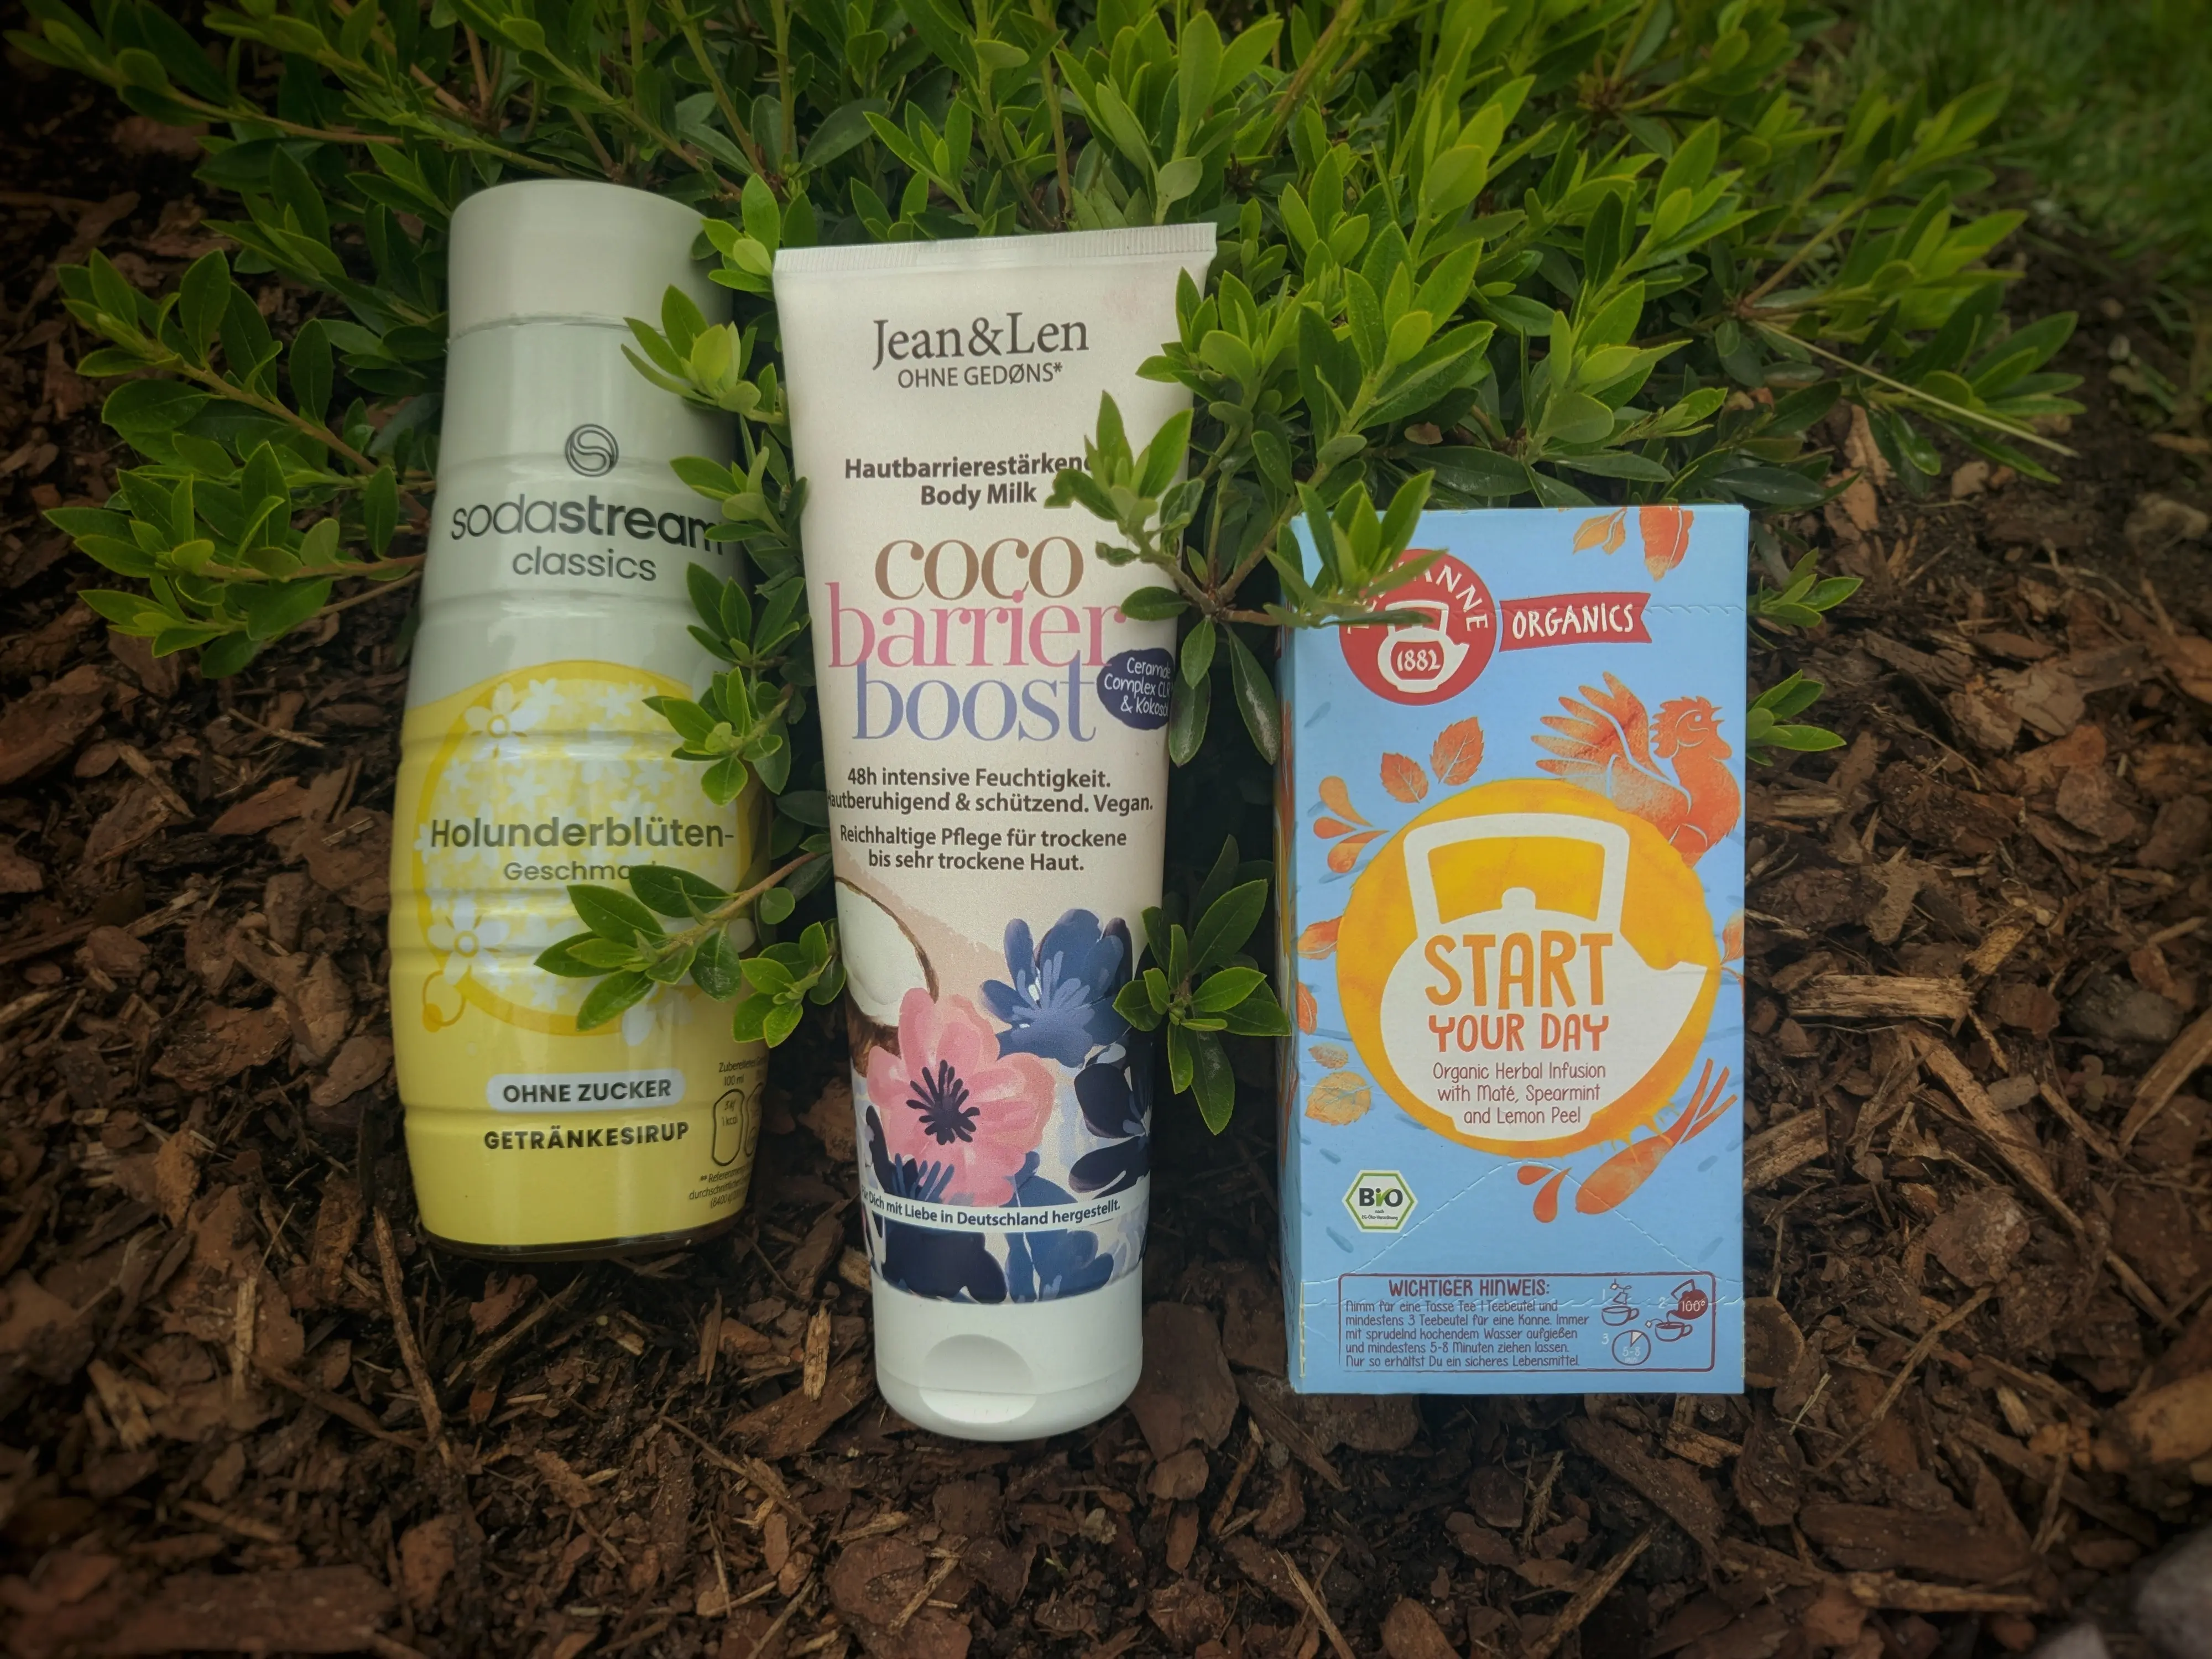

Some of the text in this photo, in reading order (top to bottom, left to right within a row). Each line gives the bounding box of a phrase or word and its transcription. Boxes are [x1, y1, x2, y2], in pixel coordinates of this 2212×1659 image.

[873, 312, 1089, 371] Jean&Len
[898, 367, 958, 388] OHNE
[844, 452, 1092, 479] Hautbarrierestärken
[921, 482, 1037, 510] Body Milk
[451, 494, 723, 556] sodastream
[513, 546, 656, 581] classics
[875, 536, 1084, 600] coco
[825, 582, 1127, 667] barrier
[1511, 603, 1634, 639] ORGANICS
[1397, 649, 1440, 672] 1882
[852, 650, 1096, 742] boost
[1104, 673, 1156, 699] Complex
[1120, 695, 1133, 714] &
[847, 766, 1111, 792] 48h intensive Feuchtigkeit.
[956, 792, 971, 811] &
[975, 792, 1089, 813] schützend.
[1093, 794, 1153, 817] Vegan.
[430, 817, 734, 848] Holunderblüten-
[840, 825, 1127, 851] Reichhaltige Pflege für trockene
[504, 860, 657, 881] Geschma
[869, 849, 1084, 871] bis sehr trockene Haut.
[1424, 930, 1613, 1010] START
[1428, 1013, 1609, 1052] YOUR DAY
[1432, 1062, 1606, 1083] Organic Herbal Infusion
[503, 1078, 672, 1103] OHNE ZUCKER
[1437, 1084, 1600, 1106] with Maté, Spearmint
[1463, 1107, 1581, 1124] and Lemon Peel
[484, 1121, 689, 1150] GETRÄNKESIRUP
[869, 1191, 885, 1209] Dich
[886, 1202, 902, 1215] mit
[905, 1204, 937, 1222] Liebe
[941, 1210, 953, 1223] in
[957, 1211, 1048, 1226] Deutschland
[1052, 1198, 1120, 1223] hergestellt.
[1388, 1279, 1550, 1297] WICHTIGER HINWEIS:
[1345, 1300, 1375, 1312] Nimm
[1400, 1302, 1421, 1312] eine
[1425, 1301, 1454, 1312] Tasse
[1459, 1300, 1476, 1312] Tee
[1486, 1300, 1535, 1312] Teebeutel
[1539, 1300, 1558, 1312] und
[1345, 1313, 1589, 1326] mindestens 3 Teebeutel für eine Kanne. Immer
[1345, 1327, 1578, 1342] mit sprudelnd kochendem Wasser aufgießen
[1345, 1341, 1569, 1353] und mindestens 5-8 Minuten ziehen lassen.
[1345, 1355, 1365, 1366] Nur
[1369, 1358, 1381, 1366] so
[1384, 1355, 1425, 1366] erhältst
[1430, 1355, 1443, 1366] Du
[1446, 1355, 1462, 1366] ein
[1465, 1355, 1509, 1366] sicheres
